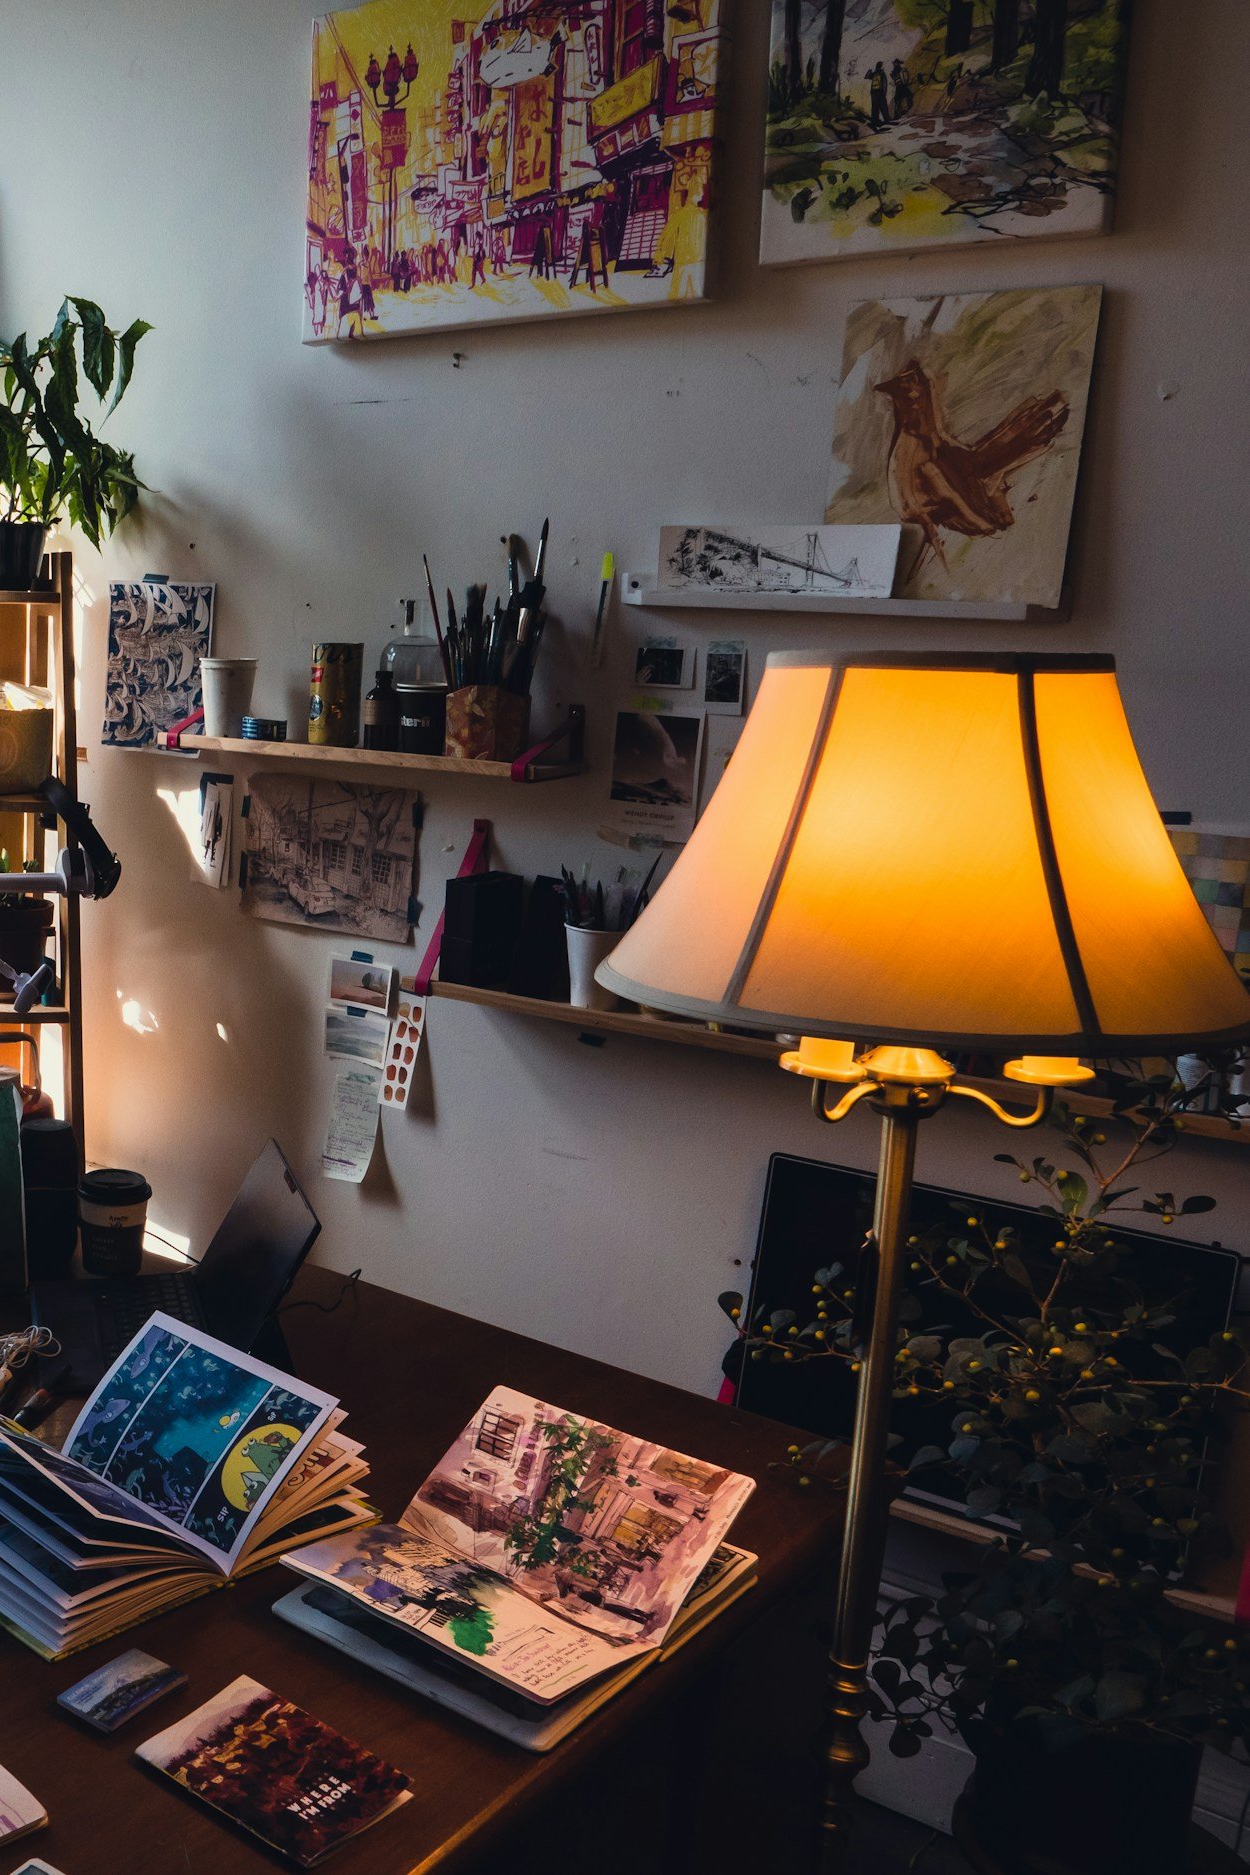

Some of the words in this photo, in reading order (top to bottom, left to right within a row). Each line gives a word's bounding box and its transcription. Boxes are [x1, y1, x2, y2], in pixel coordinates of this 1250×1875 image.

[287, 1775, 341, 1813] WHERE
[298, 1806, 320, 1821] I'M
[318, 1782, 352, 1810] FROM
